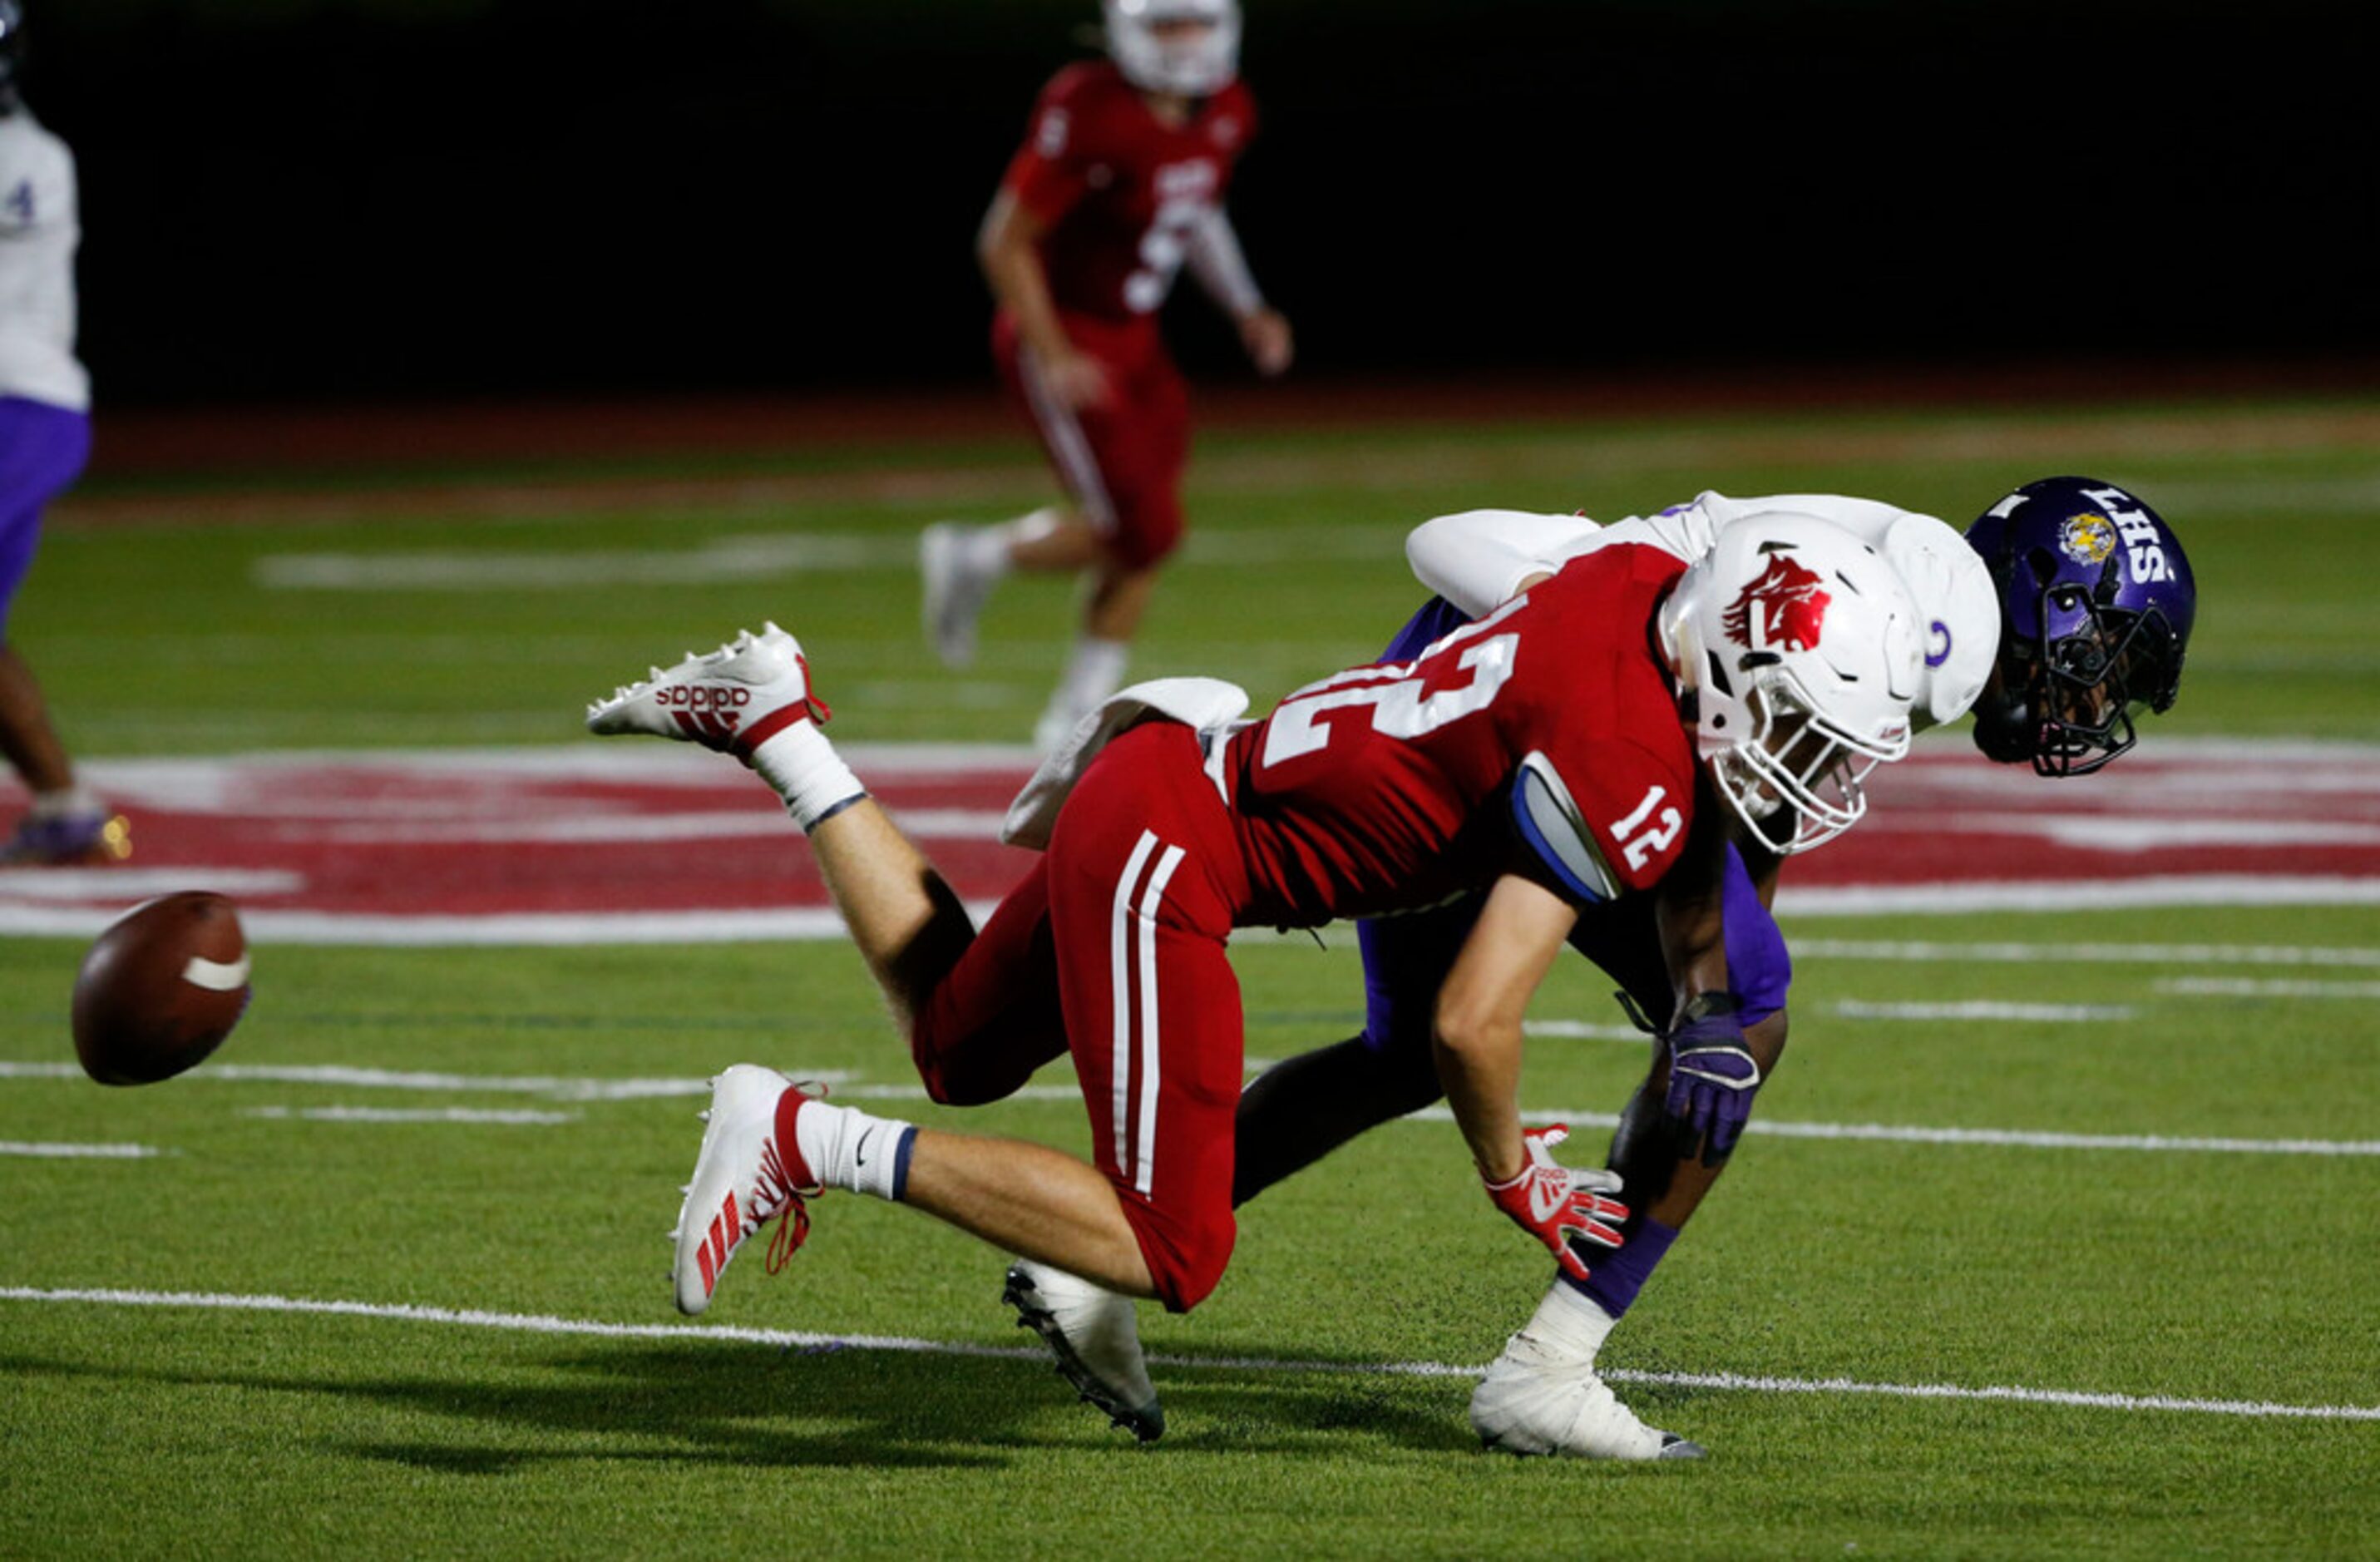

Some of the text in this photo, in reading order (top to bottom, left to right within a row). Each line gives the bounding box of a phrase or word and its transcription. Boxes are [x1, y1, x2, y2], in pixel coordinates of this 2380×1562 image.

[2078, 487, 2166, 585] LHS
[655, 685, 751, 711] adidas
[1262, 592, 1529, 769] 12
[1609, 784, 1683, 872] 12
